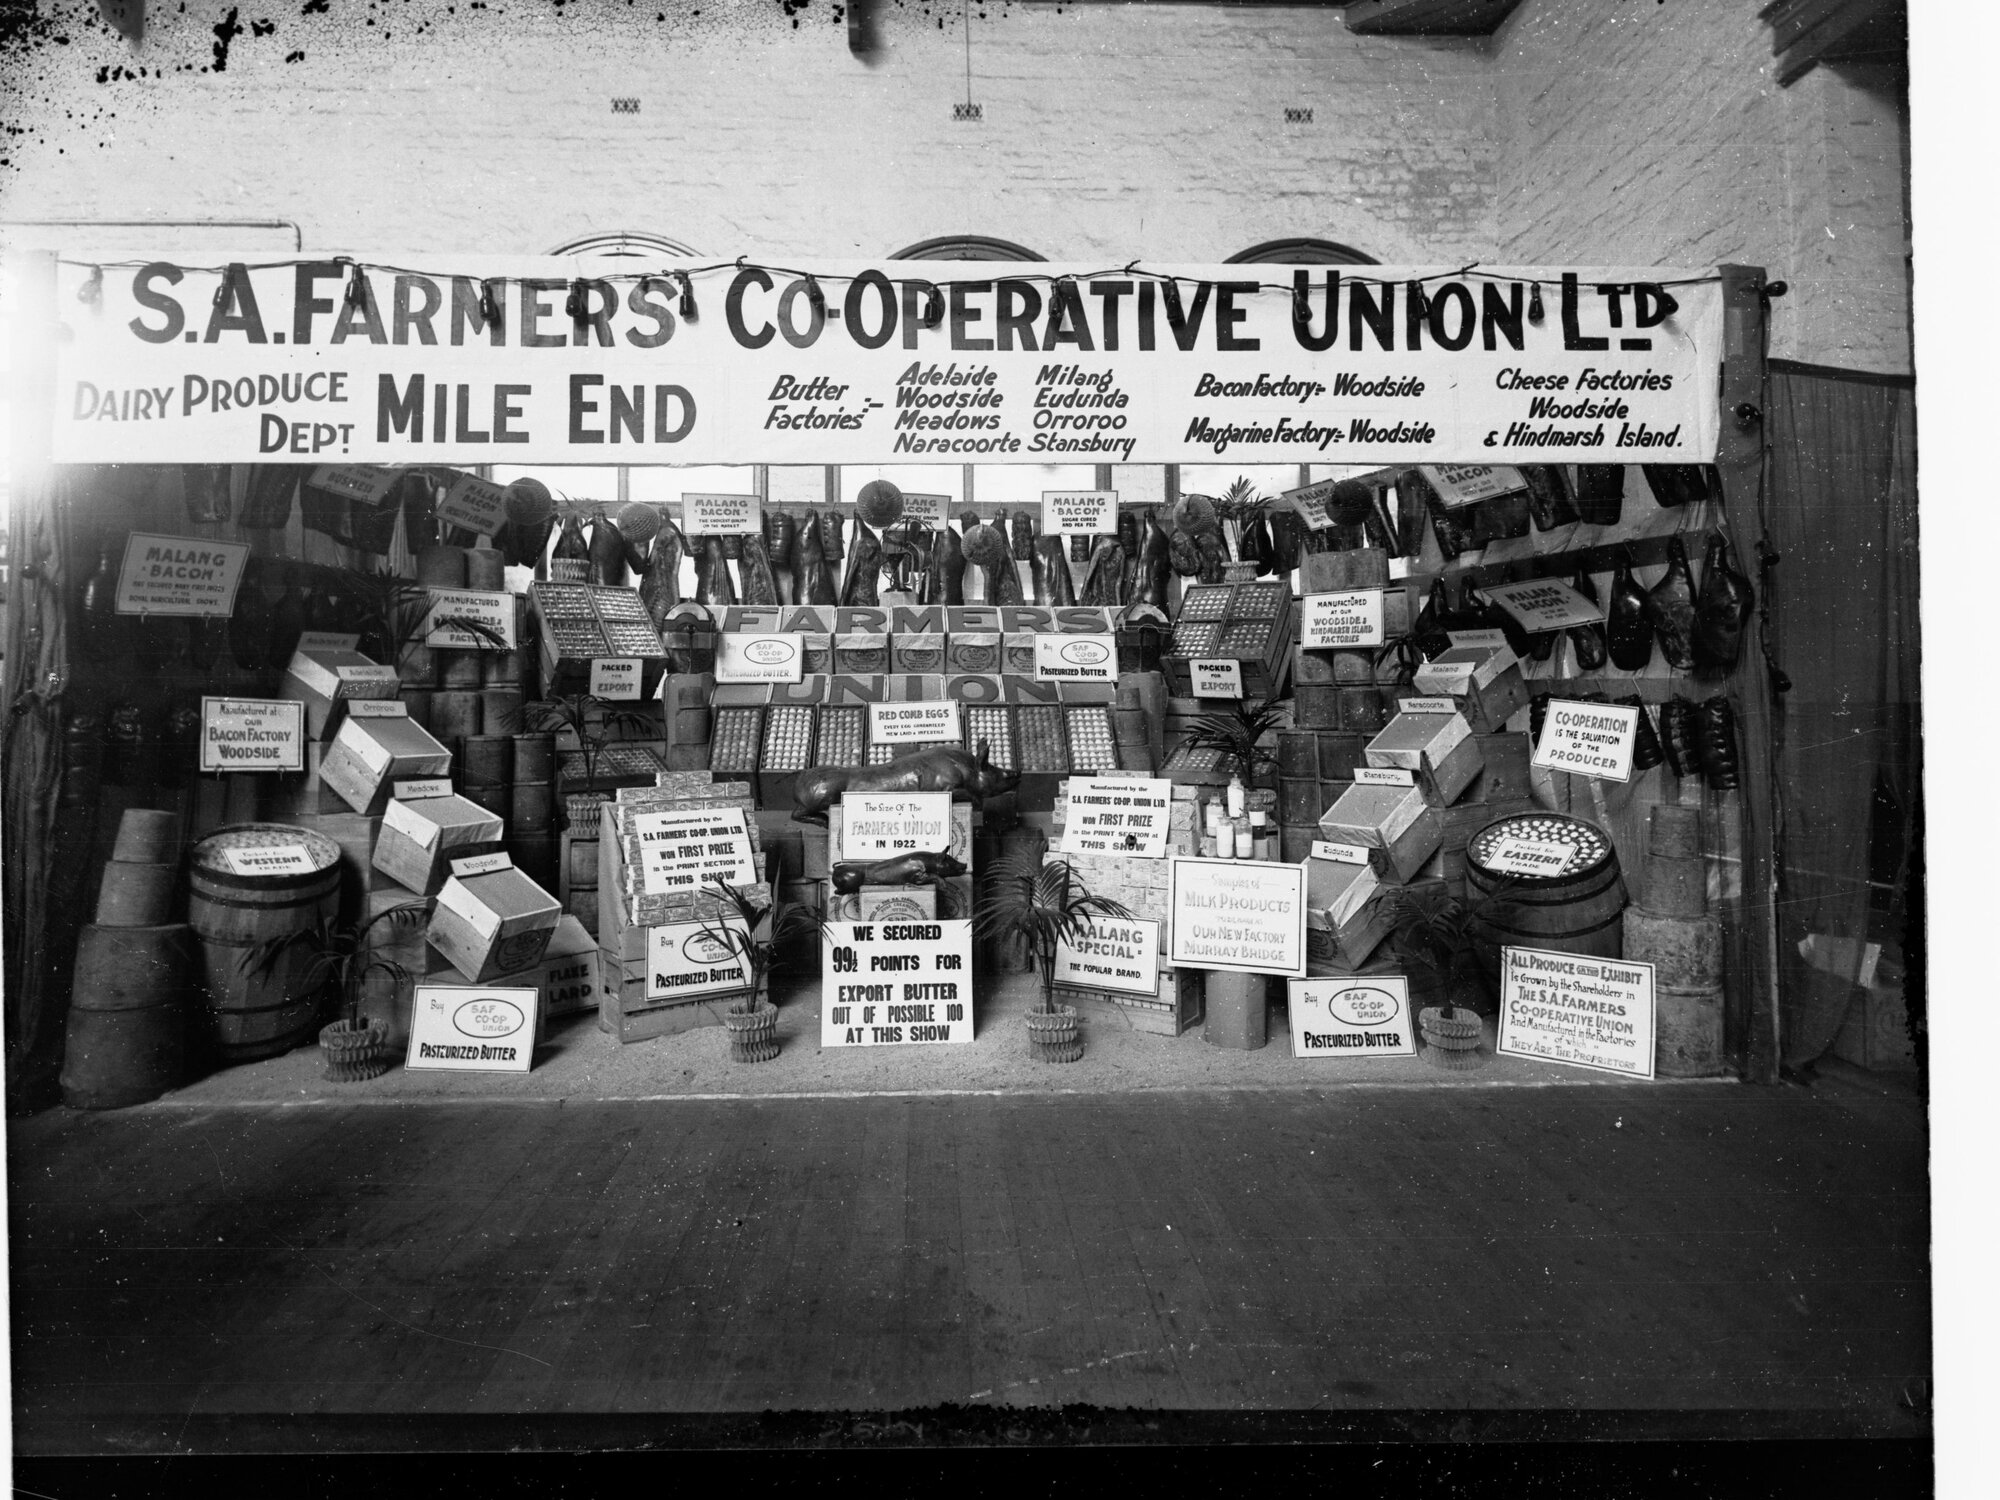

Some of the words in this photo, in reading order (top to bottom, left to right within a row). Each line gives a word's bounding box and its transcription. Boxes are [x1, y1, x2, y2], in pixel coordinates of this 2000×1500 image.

[726, 269, 1260, 351] CO-OPERATIVE
[1292, 270, 1525, 351] UNION
[896, 362, 998, 386] Adelaide
[1035, 365, 1113, 393] Milang
[1194, 373, 1252, 397] Bacon
[1334, 373, 1425, 397] Woodside
[1496, 368, 1570, 390] Cheese
[1575, 368, 1674, 391] Factories
[768, 375, 849, 401] Butter
[73, 381, 174, 421] DAIRY
[183, 372, 348, 416] PRODUCE
[896, 386, 1004, 408] Woodside
[1034, 387, 1129, 408] Eudunda
[377, 374, 531, 443] MILE
[569, 374, 697, 443] END
[1528, 397, 1630, 419] Woodside
[764, 405, 865, 430] Factories
[894, 409, 1001, 430] Meadows
[1033, 409, 1127, 430] Orroroo
[1184, 417, 1274, 454] Margarine
[1349, 419, 1435, 443] Woodside
[1484, 431, 1499, 447] &
[1503, 422, 1605, 447] Hindmarsh
[1615, 422, 1683, 447] Island.
[892, 432, 1021, 453] Naracoorte
[1027, 433, 1136, 461] Stansbury
[695, 499, 748, 507] MALANG
[1053, 498, 1106, 506] MALANG
[701, 508, 740, 516] BACON
[1057, 507, 1100, 516] BACON
[146, 547, 227, 567] MALANG
[150, 565, 213, 580] BACON
[444, 596, 499, 607] MANUFACTURED
[1317, 599, 1368, 607] MANUFACTURED
[722, 606, 1109, 633] FARMERS
[1313, 616, 1361, 626] WOODSIDE
[1320, 635, 1360, 643] FACTORIES
[601, 664, 633, 672] PACKED
[1040, 665, 1079, 676] PASTEURIZED
[1080, 667, 1108, 676] BUTTER
[1198, 664, 1233, 672] PACKED
[597, 683, 634, 692] EXPORT
[771, 675, 1060, 704] UNION
[1200, 682, 1236, 692] EXPORT
[220, 704, 268, 715] Manufactured
[879, 711, 897, 720] RED
[899, 710, 923, 719] COMB
[925, 709, 950, 718] EGGS
[1555, 711, 1629, 733] CO-OPERATION
[209, 727, 246, 742] BACON
[248, 728, 291, 742] FACTORY
[1555, 728, 1564, 737] IS
[1566, 730, 1579, 740] THE
[1581, 732, 1621, 745] SALVATION
[218, 744, 281, 759] WOODSIDE
[1587, 744, 1600, 752] THE
[1549, 749, 1618, 769] PRODUCER
[1363, 772, 1401, 782] Stansbury
[865, 802, 878, 812] The
[878, 803, 894, 812] Size
[1133, 797, 1151, 807] UNION
[660, 817, 702, 825] Manufactured
[851, 820, 900, 836] FARMERS
[904, 820, 942, 836] UNION
[1082, 815, 1096, 825] WON
[1099, 813, 1124, 826] FIRST
[1127, 814, 1153, 827] PRIZE
[710, 827, 729, 836] UNION
[659, 850, 676, 860] WON
[678, 844, 704, 858] FIRST
[708, 842, 735, 856] PRIZE
[875, 840, 886, 848] IN
[893, 840, 916, 848] 1922
[1080, 840, 1106, 850] THIS
[238, 856, 302, 866] WESTERN
[464, 859, 498, 869] Woodside
[676, 862, 700, 870] PRINT
[703, 859, 736, 868] SECTION
[1502, 850, 1562, 865] EASTERN
[665, 874, 694, 886] THIS
[701, 870, 736, 882] SHOW
[1185, 891, 1217, 908] MILK
[1220, 893, 1291, 913] PRODUCTS
[853, 926, 874, 941] WE
[883, 925, 942, 941] SECURED
[1192, 925, 1217, 939] OUR
[1219, 927, 1243, 940] NEW
[1244, 928, 1285, 944] FACTORY
[1077, 941, 1135, 959] SPECIAL
[1184, 940, 1239, 957] MURRAY
[1241, 945, 1285, 961] BRIDGE
[871, 955, 920, 971] POINTS
[936, 954, 962, 970] FOR
[1070, 962, 1081, 971] THE
[1083, 964, 1113, 975] POPULAR
[1511, 951, 1529, 969] ALL
[1529, 954, 1575, 976] PRODUCE
[1601, 966, 1643, 985] EXHIBIT
[656, 971, 708, 989] PASTEURIZED
[710, 967, 745, 983] BUTTER
[1520, 973, 1548, 986] Grown
[1549, 977, 1559, 991] by
[1561, 978, 1572, 991] the
[1573, 981, 1623, 999] Shareholders
[550, 984, 592, 1004] LARD
[839, 984, 893, 1002] EXPORT
[904, 983, 958, 1001] BUTTER
[1344, 993, 1367, 1001] SAF
[1518, 986, 1537, 1001] THE
[832, 1006, 851, 1025] OUT
[863, 1005, 876, 1024] OF
[888, 1004, 935, 1023] POSSIBLE
[947, 1003, 964, 1022] 100
[1357, 1010, 1387, 1018] UNION
[1510, 1000, 1594, 1028] CO-OPERATIVE
[1596, 1014, 1634, 1035] UNION
[483, 1024, 511, 1032] UNION
[846, 1027, 864, 1044] AT
[872, 1027, 903, 1043] THIS
[910, 1025, 950, 1043] SHOW
[1510, 1014, 1526, 1029] And
[1526, 1016, 1577, 1038] Manufactured
[1596, 1030, 1637, 1048] Factories
[1304, 1031, 1364, 1048] PASTEURIZED
[1364, 1031, 1402, 1047] BUTTER
[420, 1042, 480, 1060] PASTEURIZED
[480, 1044, 517, 1061] BUTTER
[1510, 1036, 1533, 1052] THEY
[1534, 1041, 1553, 1056] ARE
[1555, 1045, 1573, 1059] THE
[1573, 1049, 1636, 1070] PROPRIETORS
